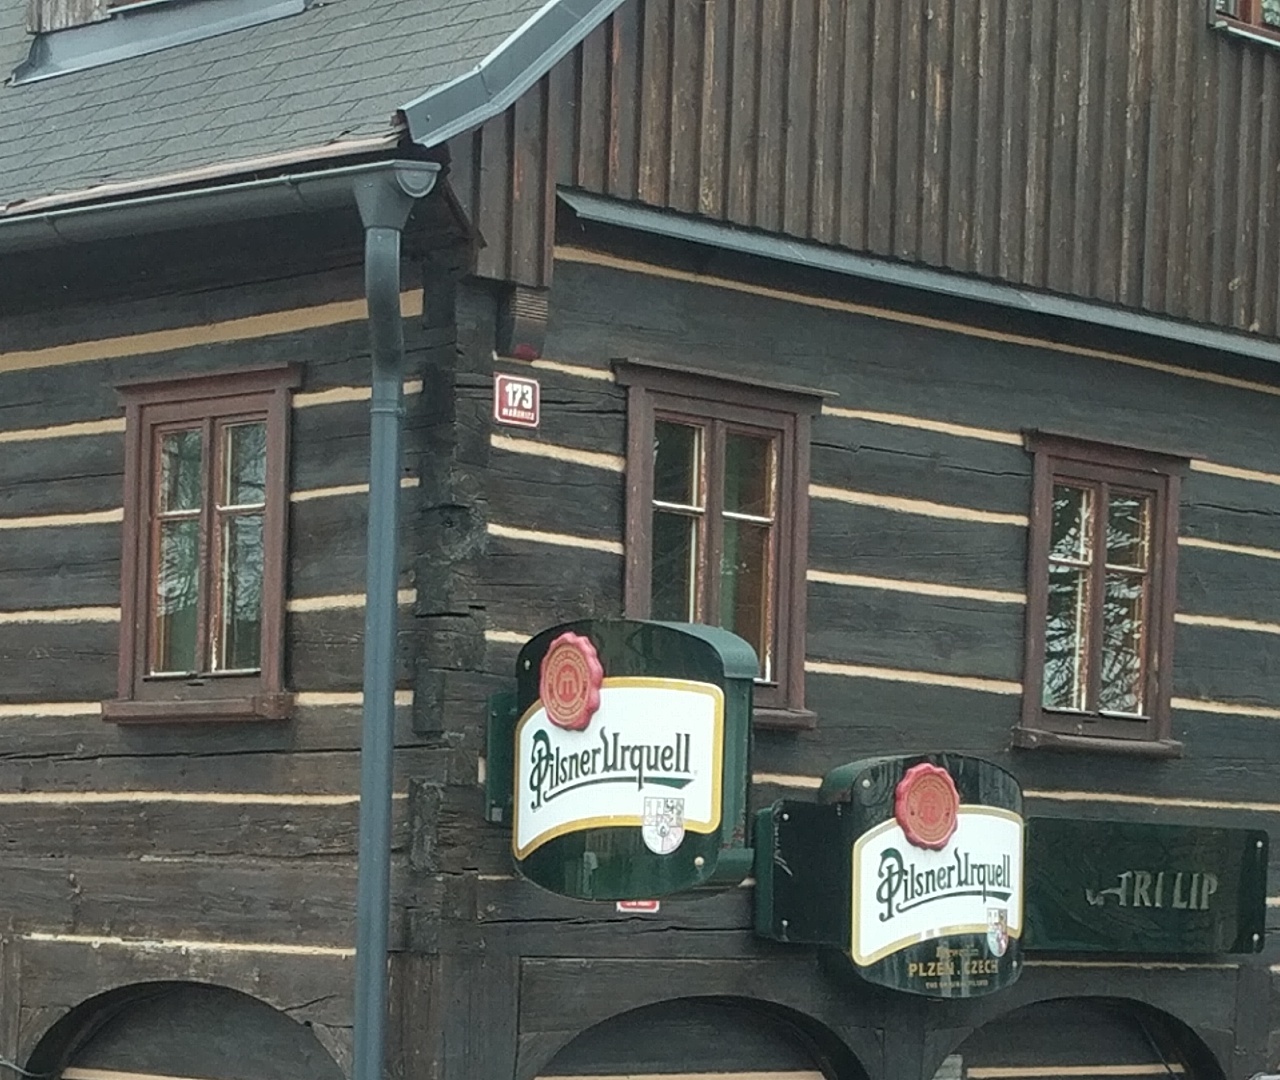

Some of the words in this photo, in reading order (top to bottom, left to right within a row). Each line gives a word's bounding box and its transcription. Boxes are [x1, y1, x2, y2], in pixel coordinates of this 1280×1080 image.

[505, 382, 532, 409] 173
[529, 729, 601, 810] Pilsner
[600, 726, 692, 792] Urquell
[876, 847, 955, 922] Pilsner
[954, 847, 1011, 904] Urquell
[1172, 871, 1218, 910] LIP
